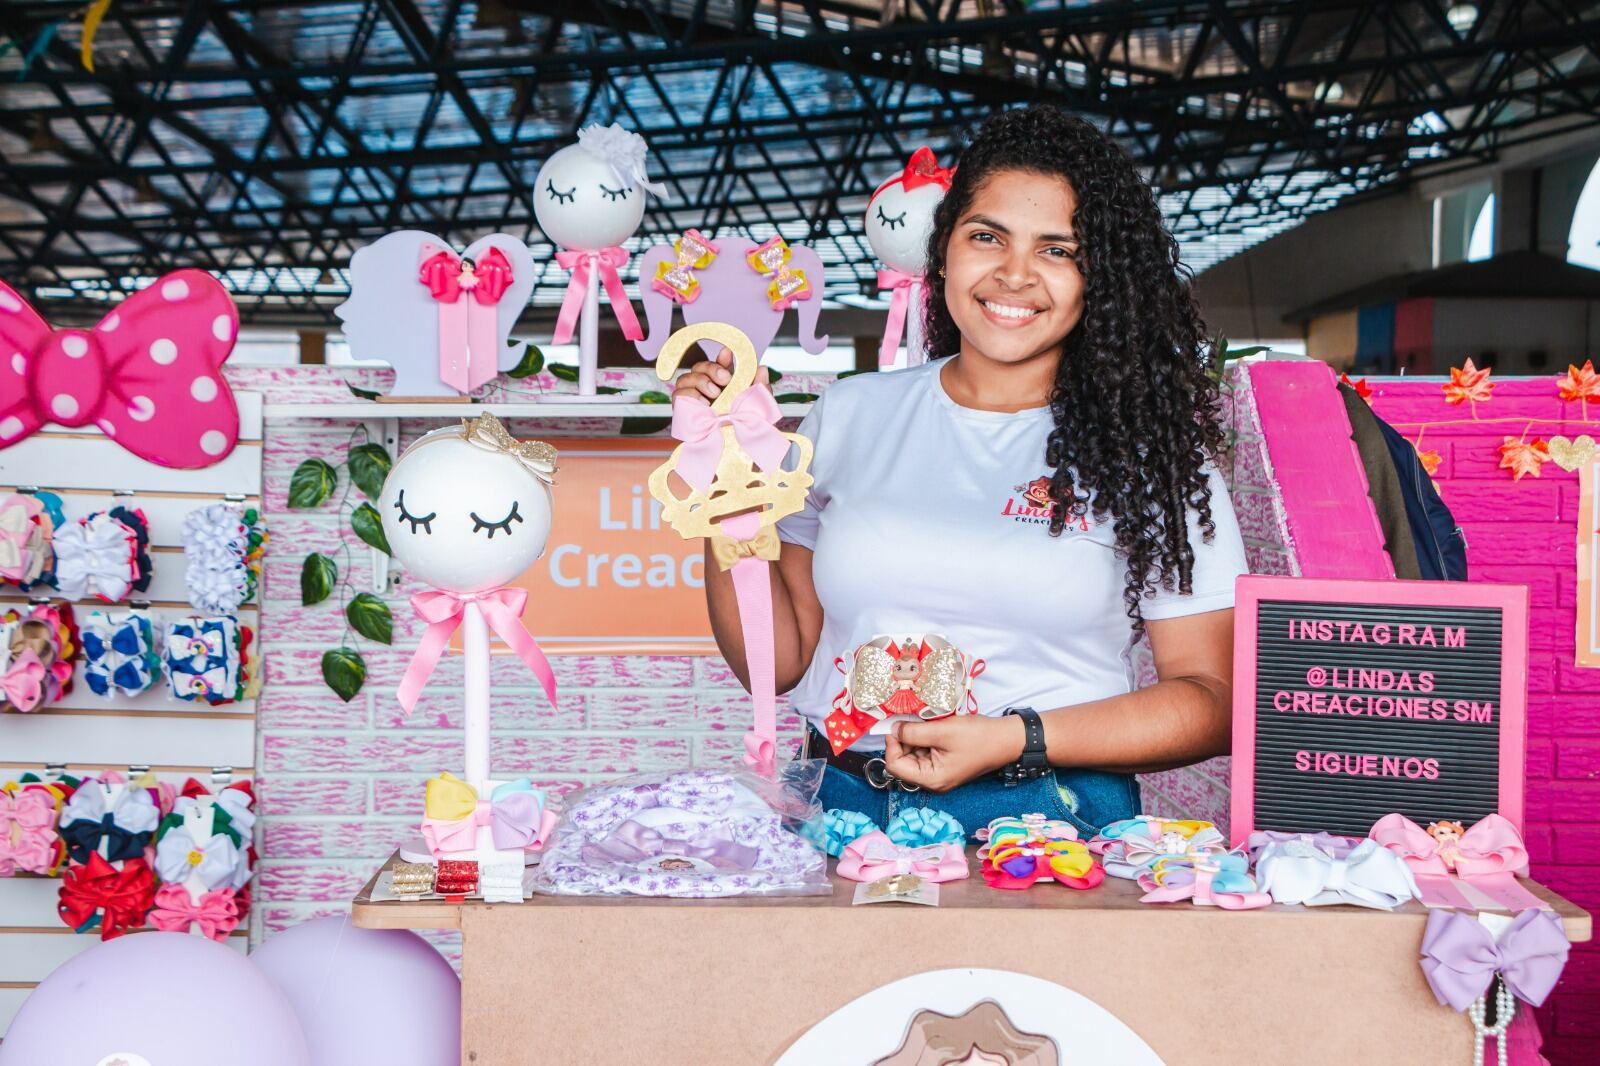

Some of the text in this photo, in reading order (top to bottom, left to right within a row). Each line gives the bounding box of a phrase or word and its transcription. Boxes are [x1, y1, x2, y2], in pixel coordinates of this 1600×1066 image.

[1288, 619, 1466, 647] INSTAGRAM
[1306, 666, 1435, 692] @LINDAS
[1295, 750, 1440, 780] SIGUENOS
